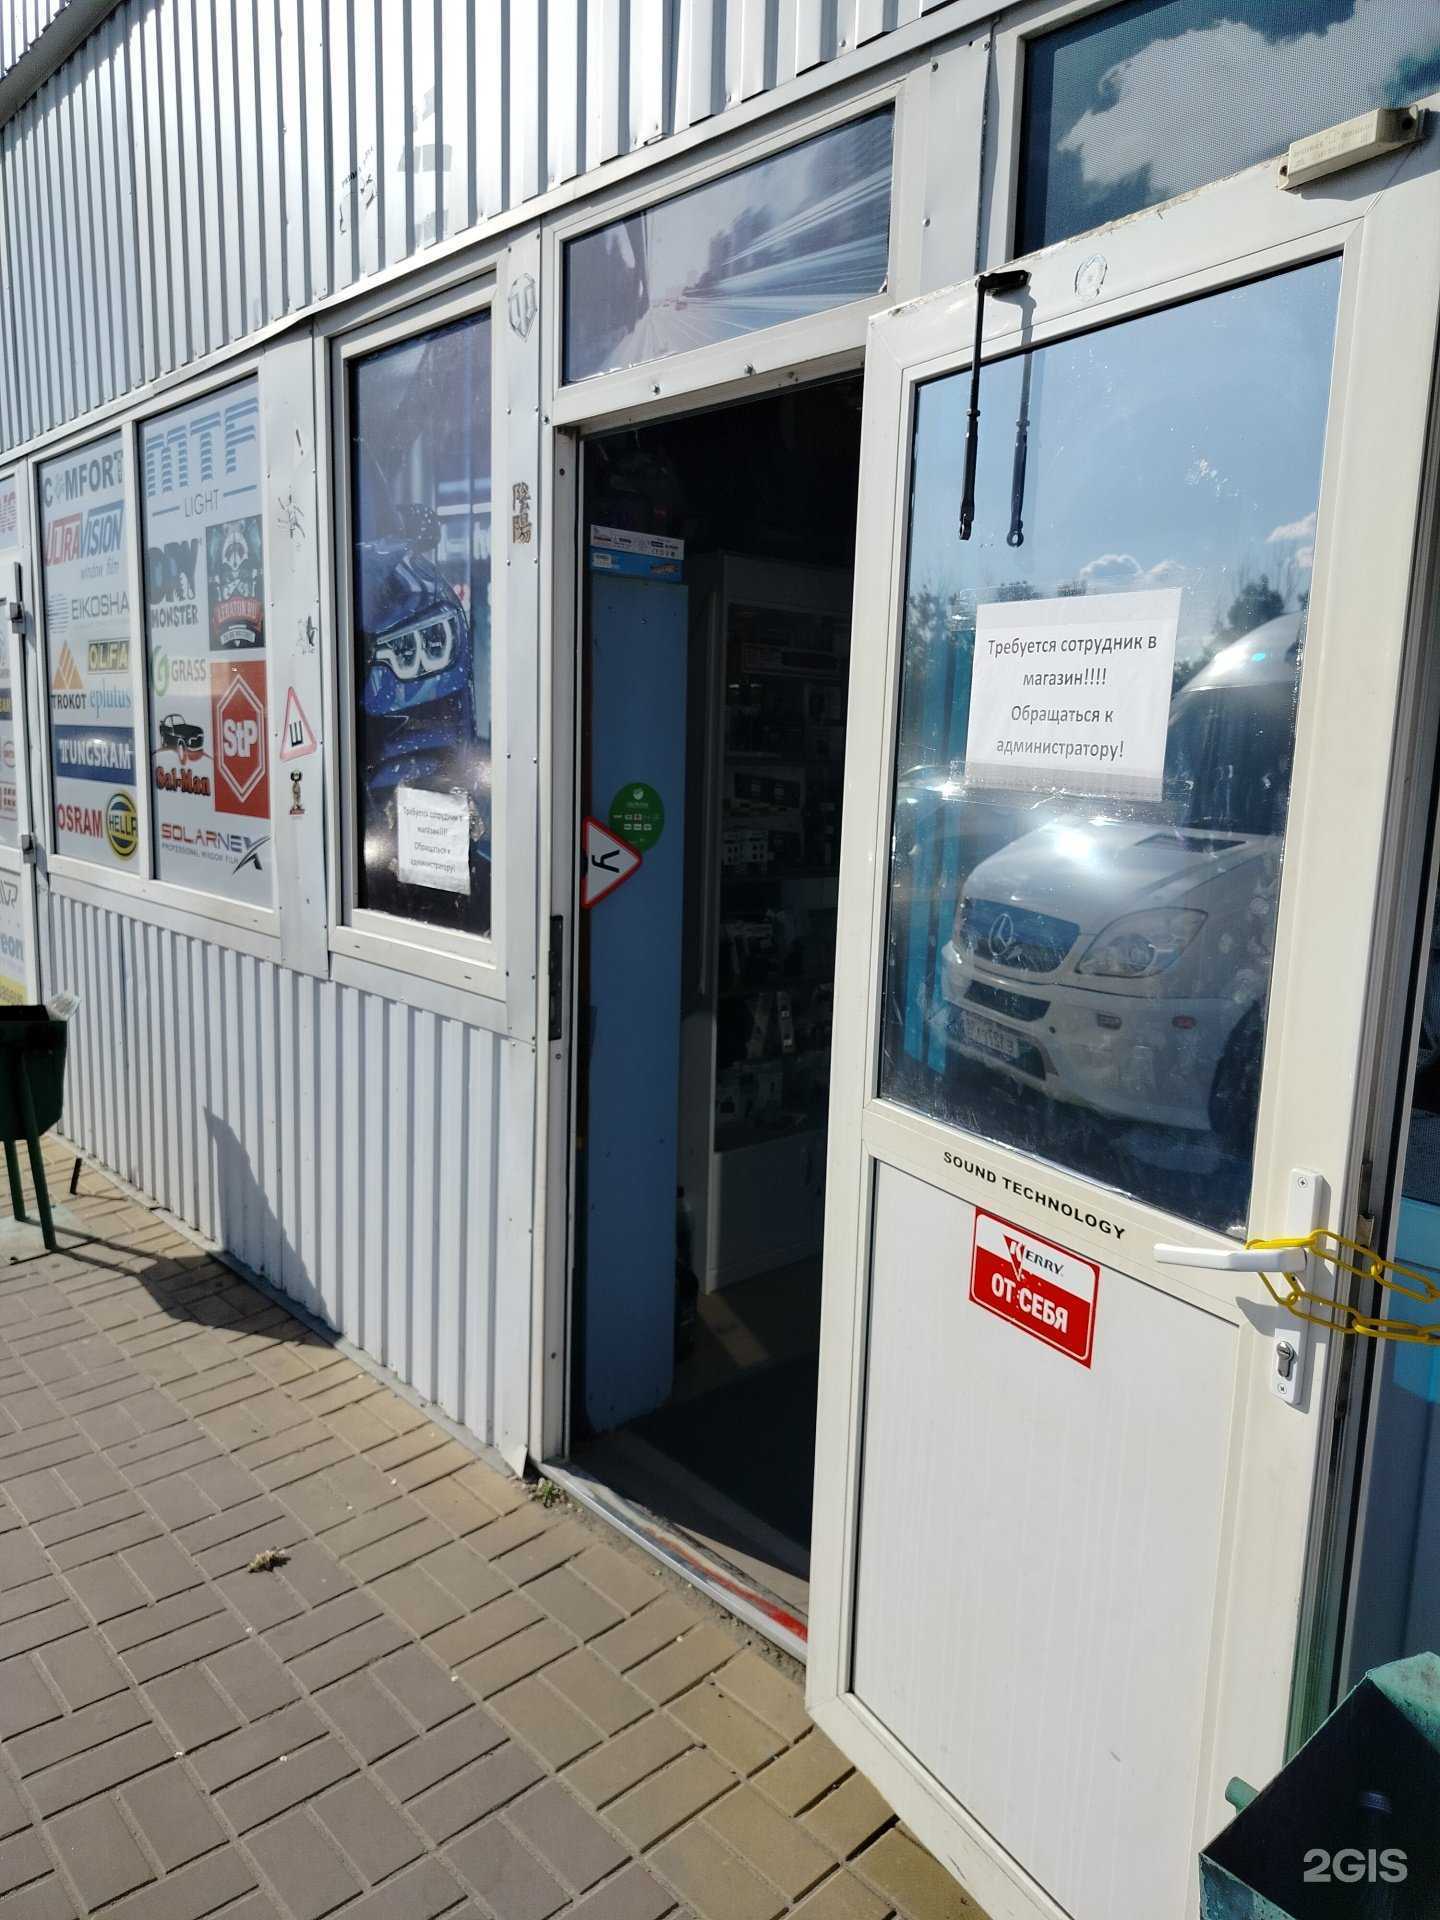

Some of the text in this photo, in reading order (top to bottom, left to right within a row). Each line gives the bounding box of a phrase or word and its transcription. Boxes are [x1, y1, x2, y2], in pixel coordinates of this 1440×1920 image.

[184, 488, 219, 518] LIGHT
[71, 591, 129, 621] EIKOSHA
[151, 604, 199, 629] MONSTER
[88, 642, 129, 670] OLFA
[988, 637, 1056, 658] Требуется
[1061, 635, 1143, 656] сотрудник
[171, 658, 207, 682] GRASS
[1023, 668, 1107, 686] магазин!!!!
[50, 693, 87, 710] TROKOT
[1011, 705, 1113, 725] Обращаться к
[59, 738, 133, 770] TUNGSRAM
[997, 739, 1124, 761] администратору!
[56, 803, 104, 839] OSRAM
[161, 822, 272, 875] SOLARNEX
[943, 1151, 1126, 1240] SOUND TECHNOLOGY
[991, 1272, 1070, 1334] ОТ СЕБЯ
